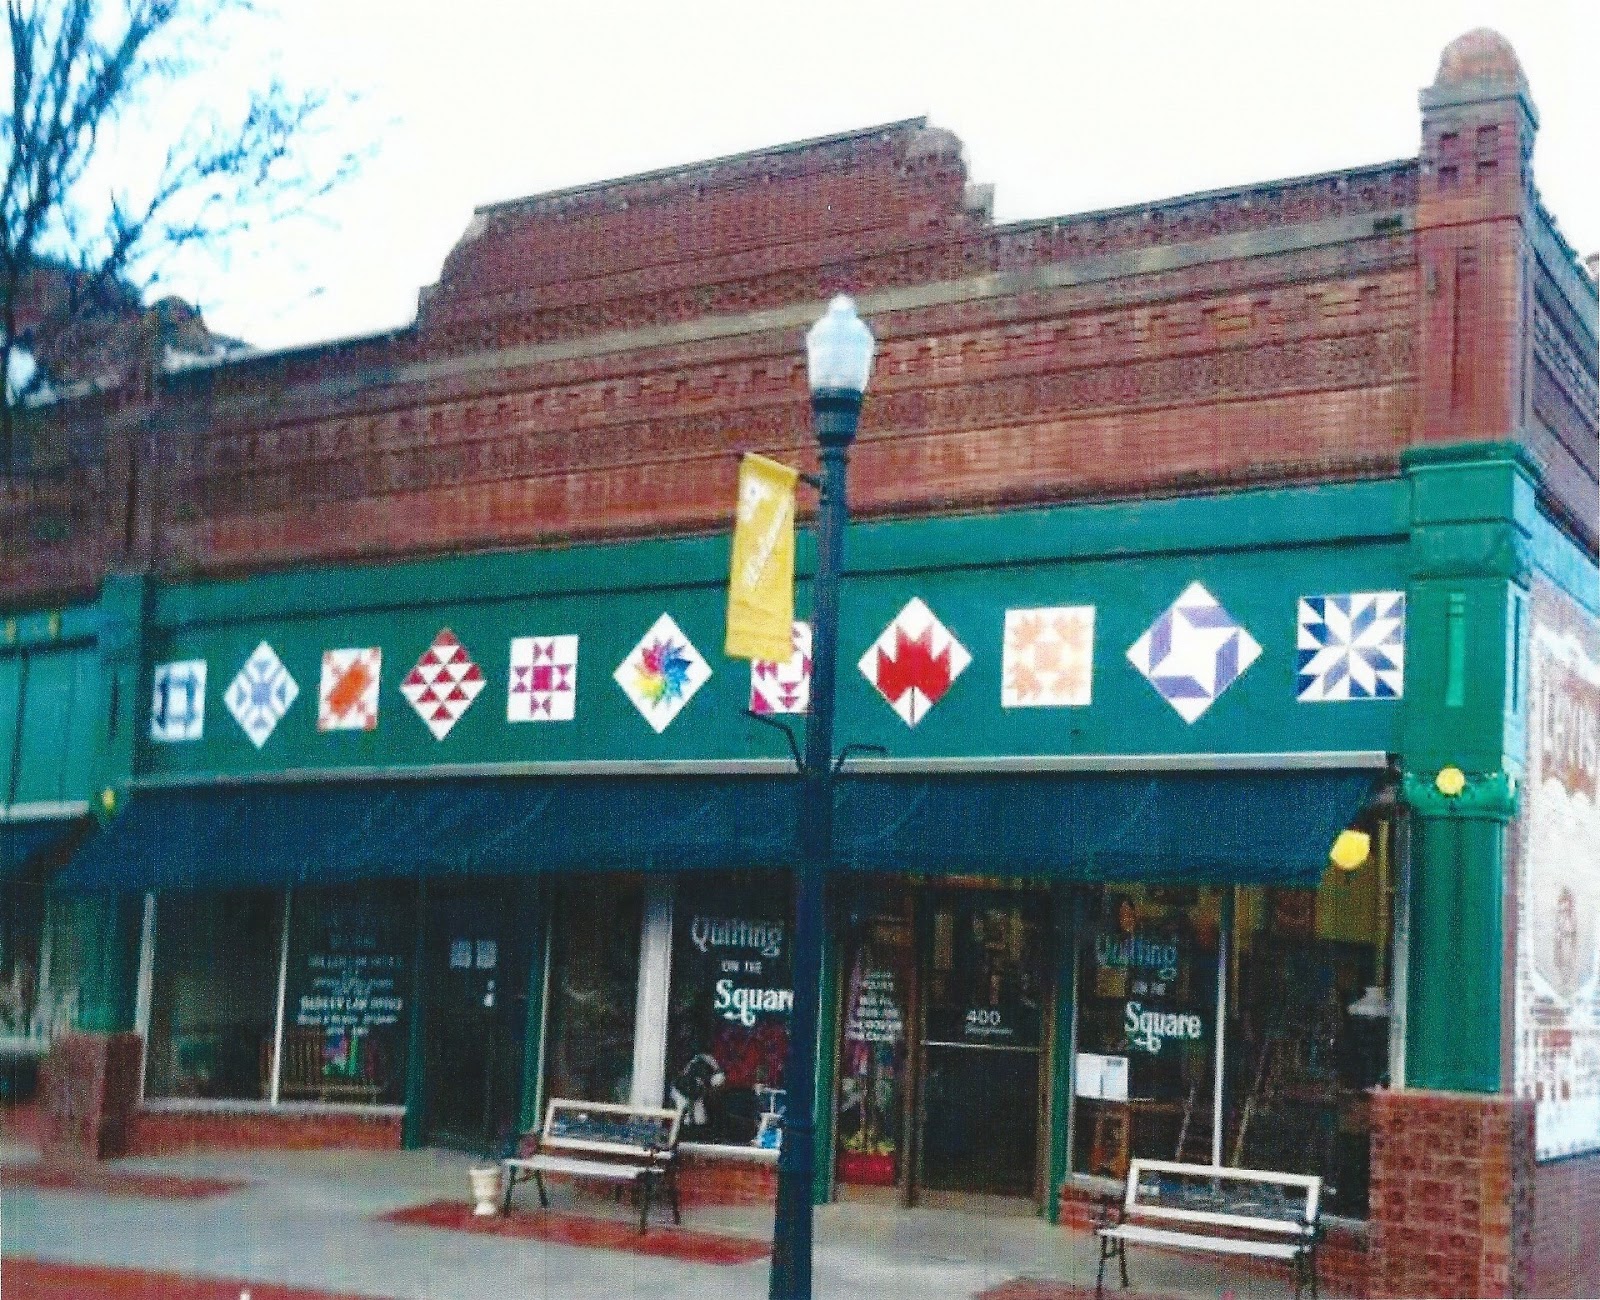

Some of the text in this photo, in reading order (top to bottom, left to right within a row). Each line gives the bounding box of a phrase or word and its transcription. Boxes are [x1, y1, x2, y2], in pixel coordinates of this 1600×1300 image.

[690, 915, 783, 957] Quilting
[713, 979, 795, 1027] Squar
[1124, 1000, 1201, 1055] Square
